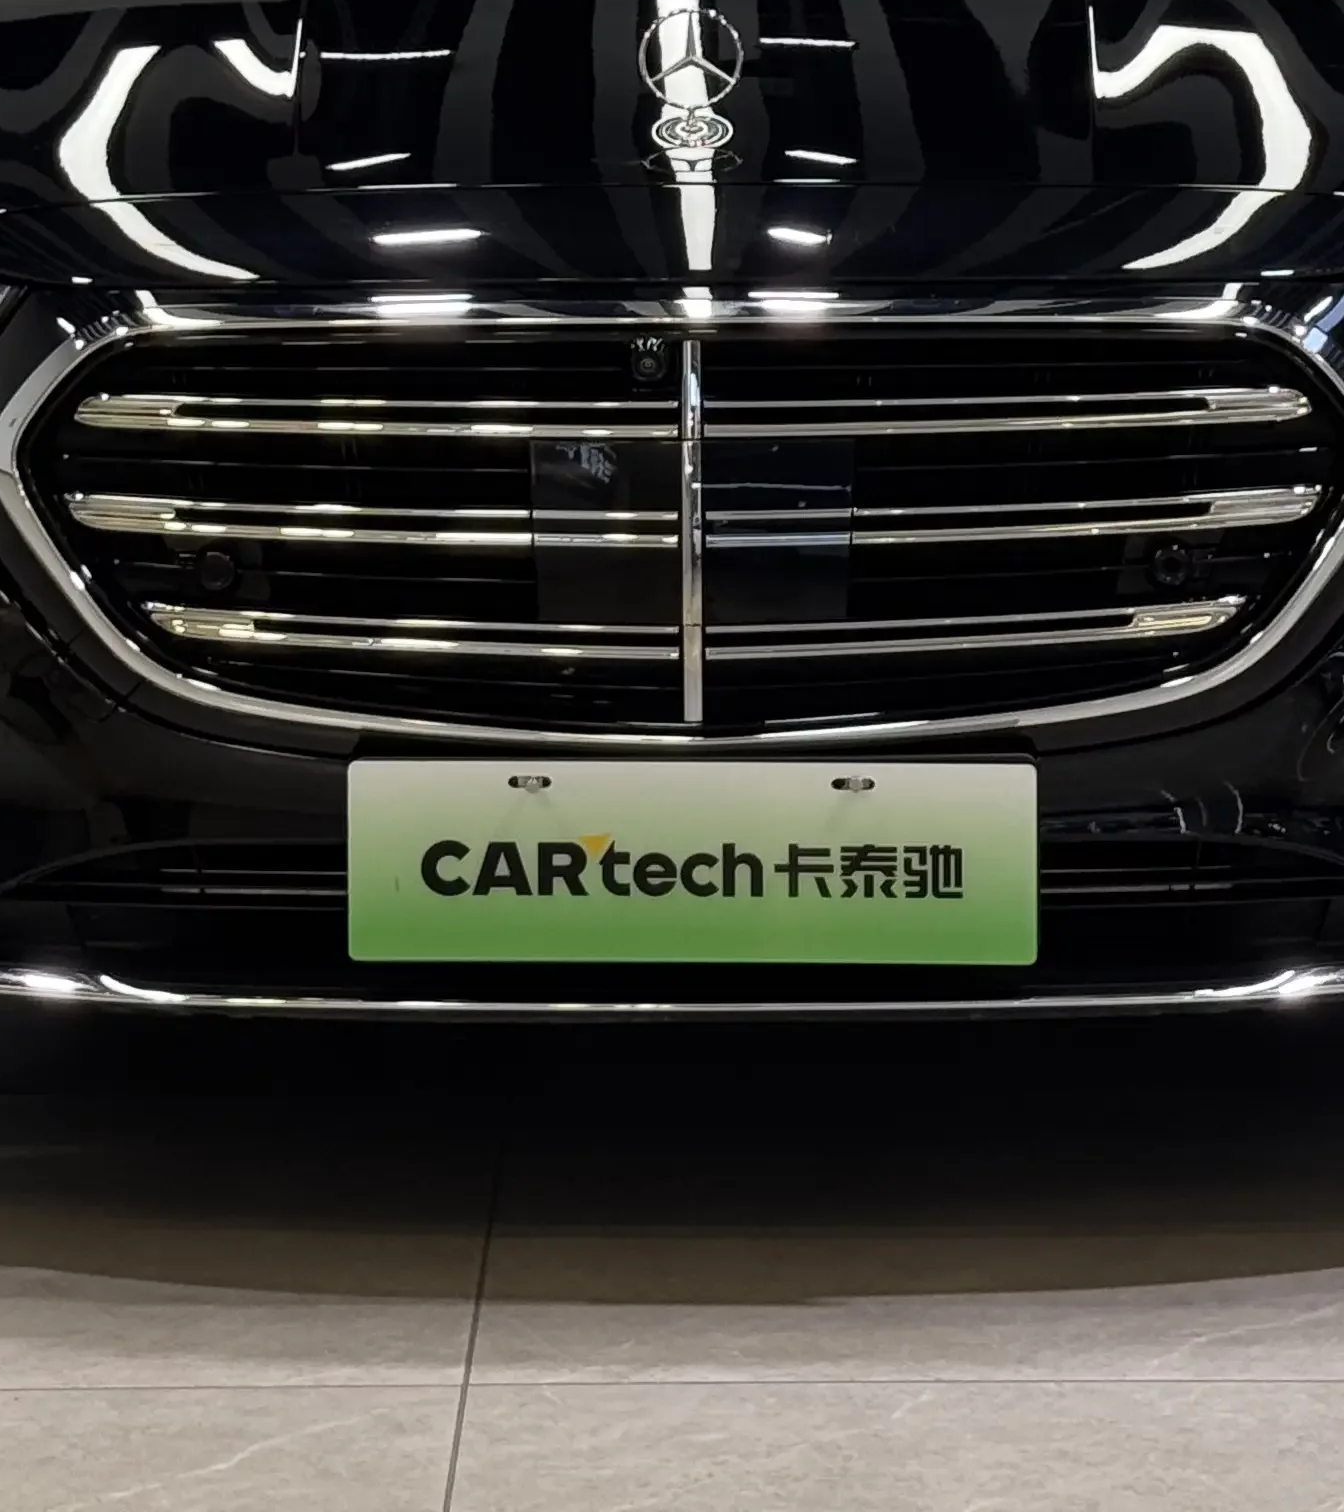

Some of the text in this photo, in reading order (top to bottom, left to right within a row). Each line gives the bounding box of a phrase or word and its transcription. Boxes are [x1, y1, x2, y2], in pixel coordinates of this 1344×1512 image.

[420, 838, 964, 899] CARtech 卡泰驰
